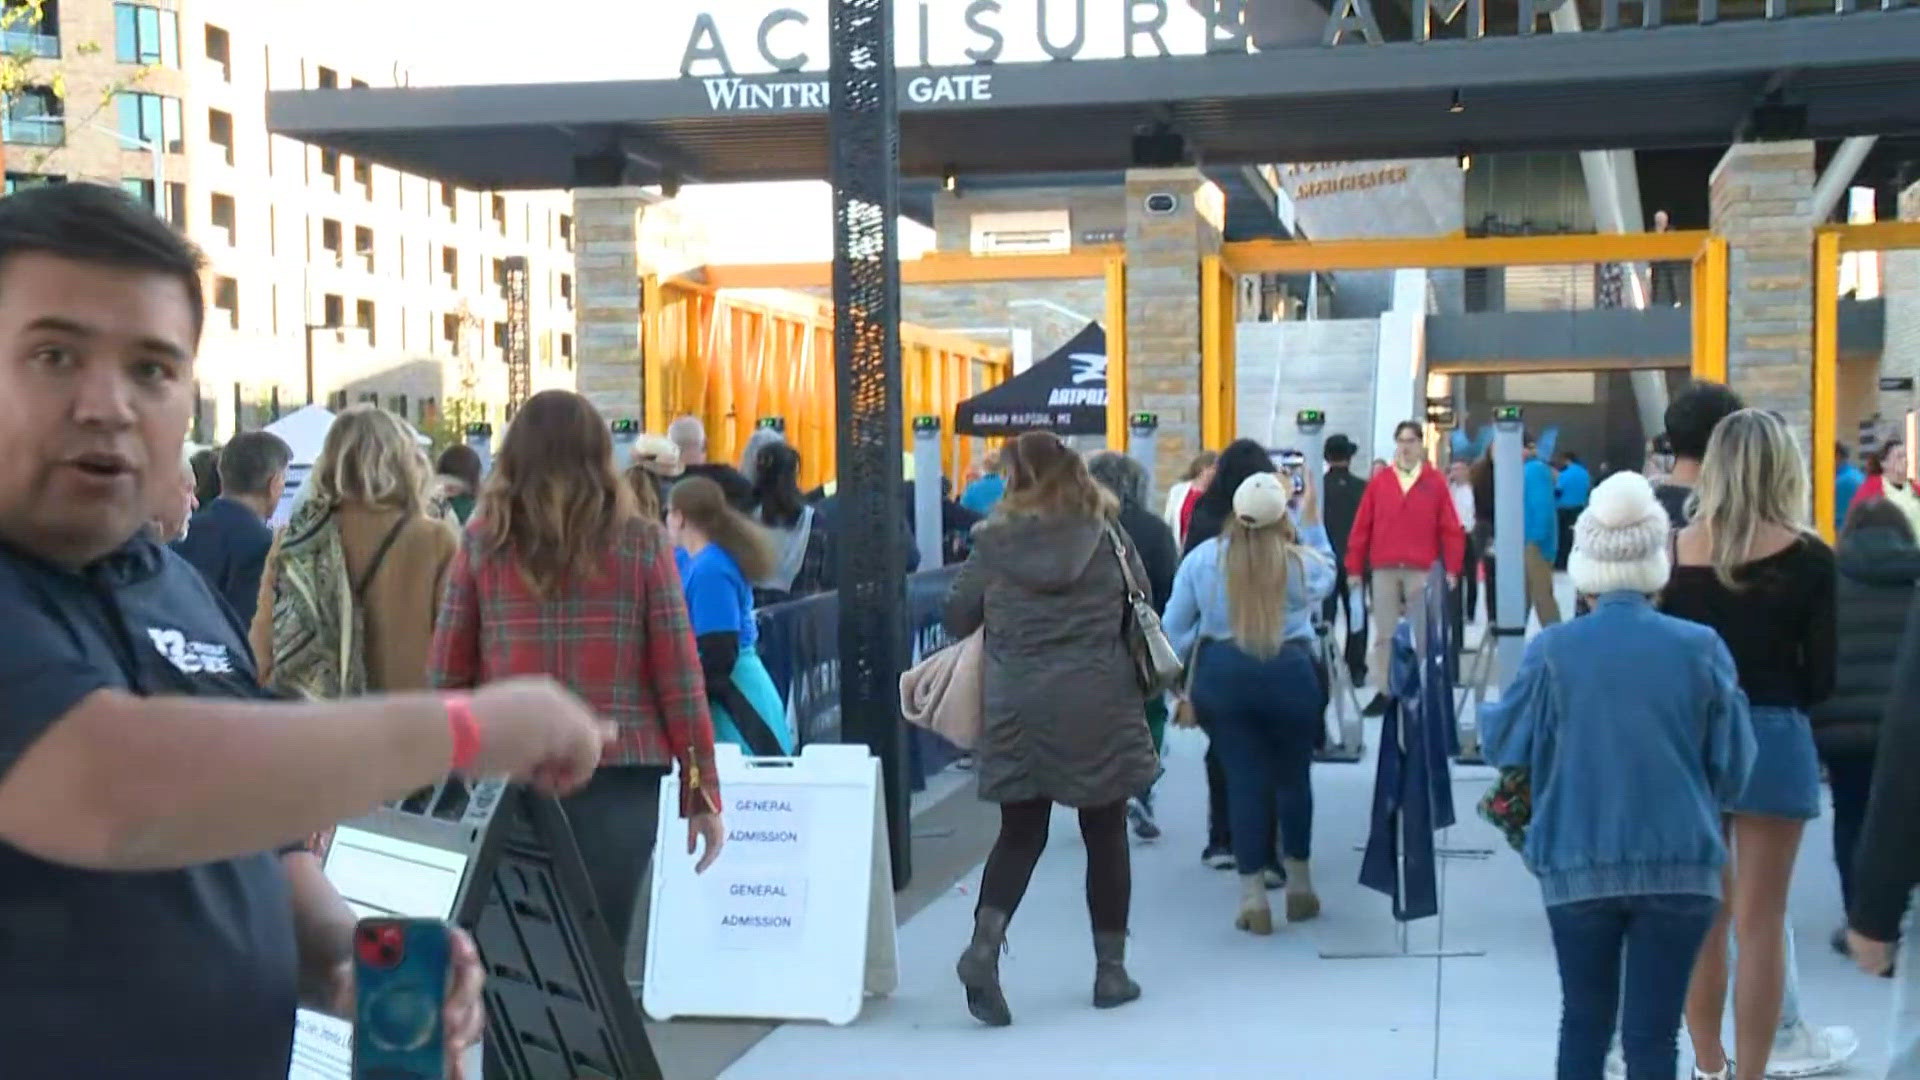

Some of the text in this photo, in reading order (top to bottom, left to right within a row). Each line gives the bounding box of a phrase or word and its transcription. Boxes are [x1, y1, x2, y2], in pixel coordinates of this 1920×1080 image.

[679, 0, 1250, 77] ACISURE
[703, 74, 992, 111] WINTR GATE
[735, 800, 793, 812] GENERAL
[727, 830, 798, 843] ADMISSION
[729, 884, 787, 897] GENERAL
[721, 915, 792, 928] ADMISSION
